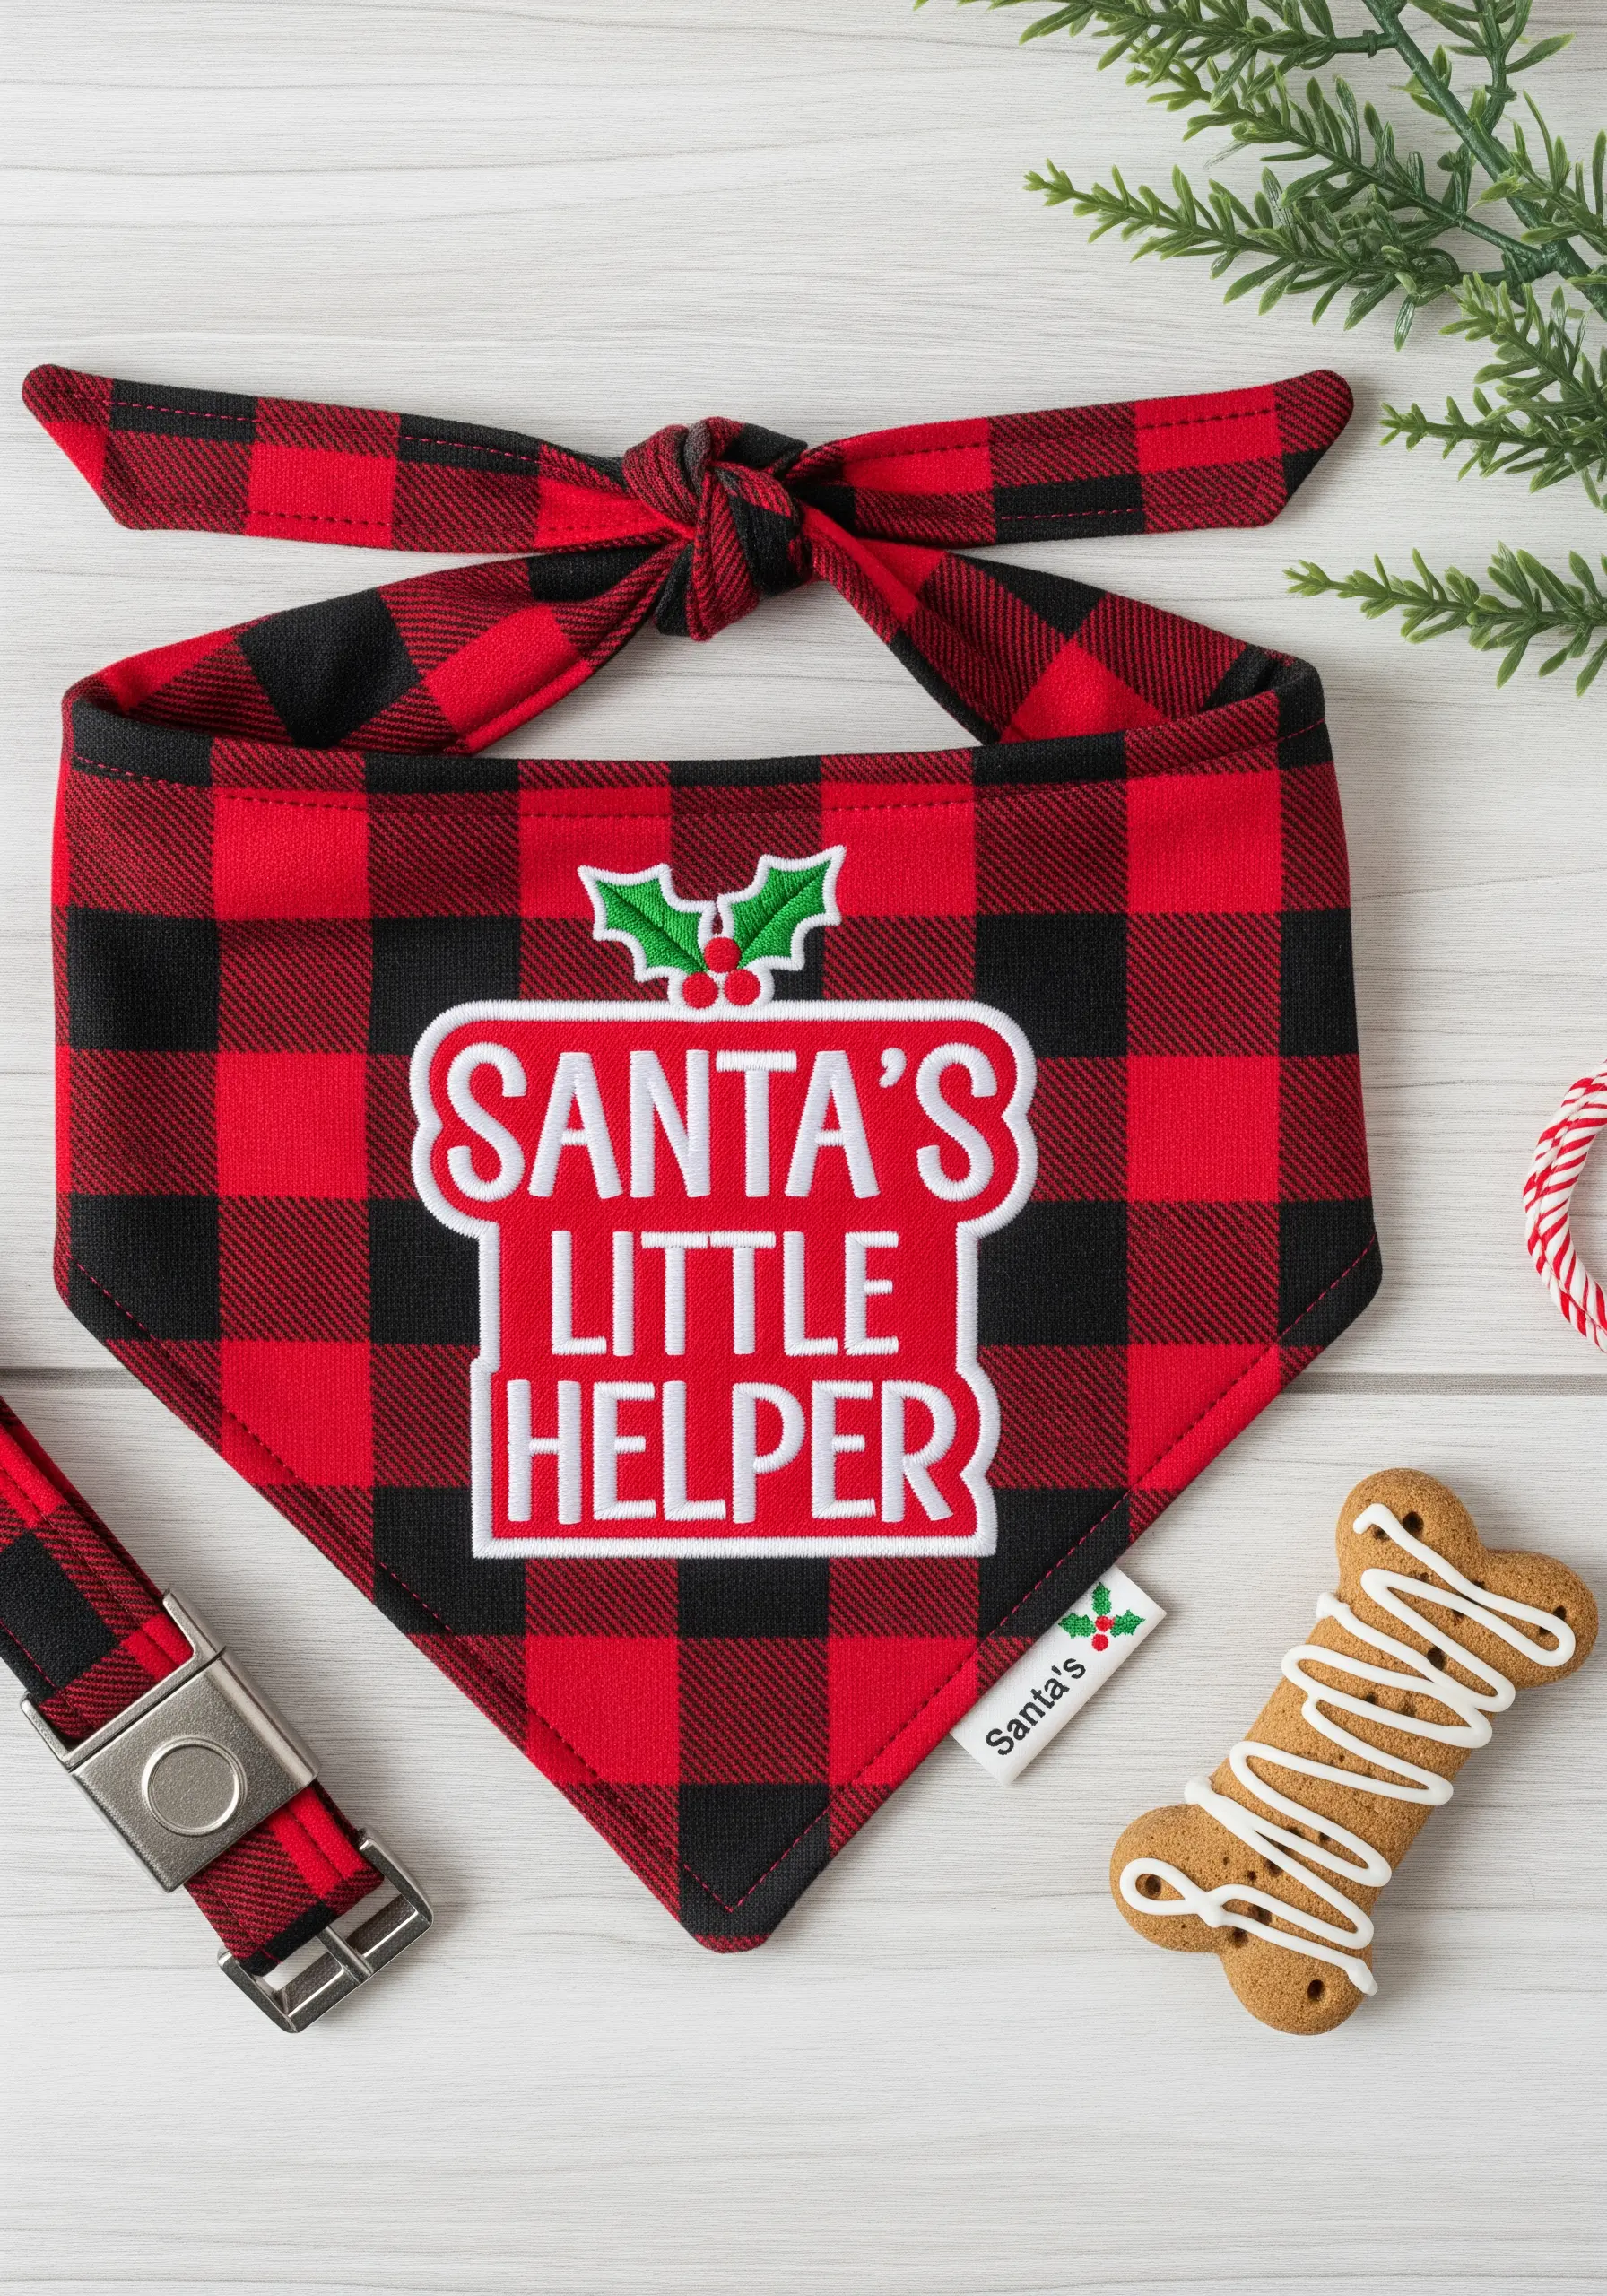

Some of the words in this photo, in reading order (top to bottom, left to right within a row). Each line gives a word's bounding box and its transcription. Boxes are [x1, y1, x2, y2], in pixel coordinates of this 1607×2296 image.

[551, 1231, 899, 1356] LITTLE
[507, 1379, 956, 1524] HELPER
[986, 1658, 1086, 1755] Santa's
